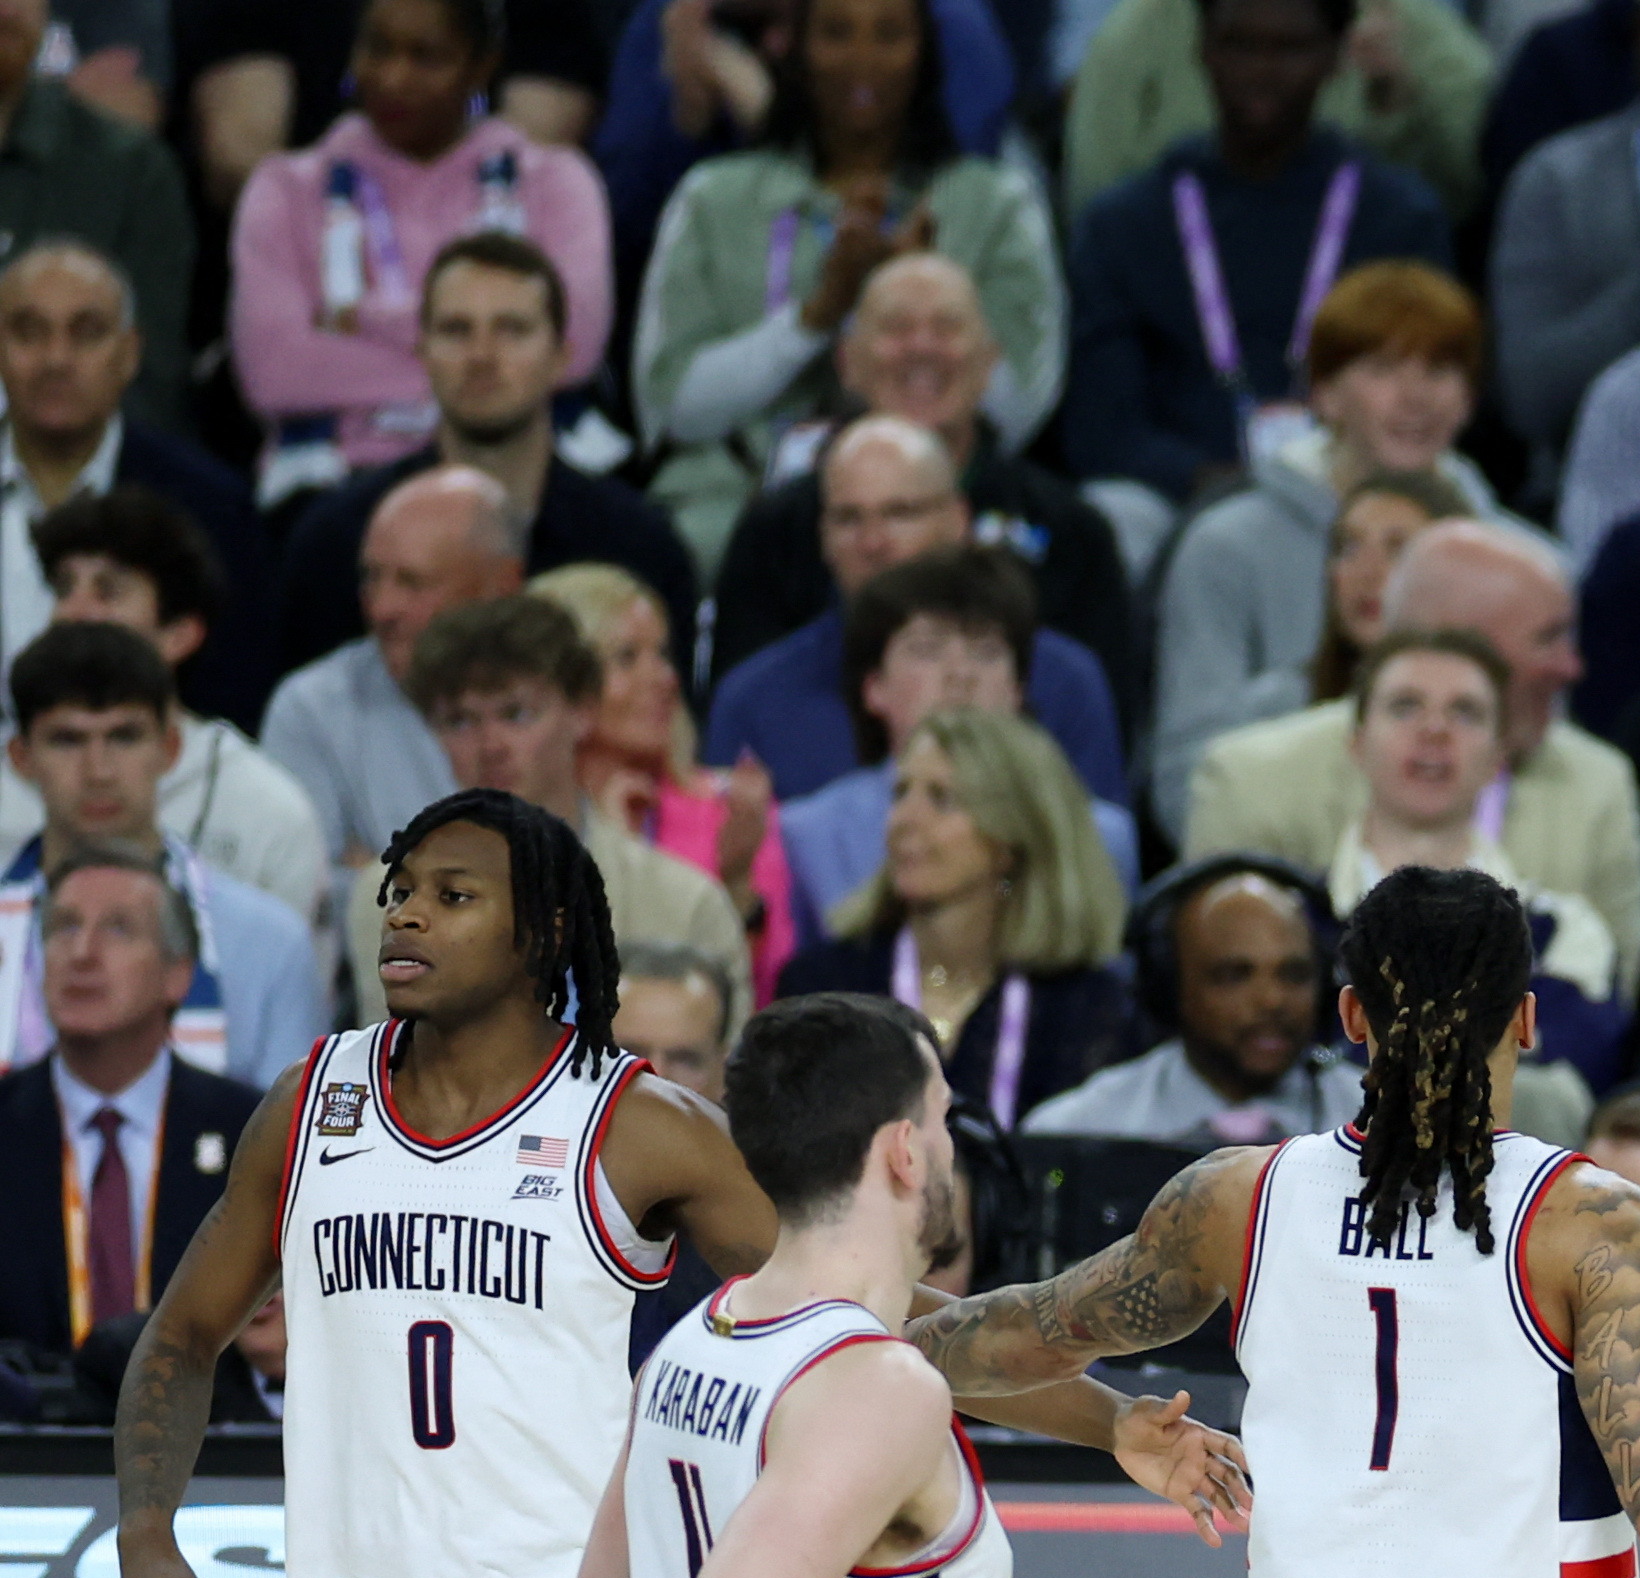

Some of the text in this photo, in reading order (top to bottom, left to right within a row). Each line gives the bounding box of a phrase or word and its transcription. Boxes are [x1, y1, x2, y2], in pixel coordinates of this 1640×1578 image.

[323, 1114, 355, 1128] FOUR
[327, 1091, 361, 1105] FINAL
[515, 1185, 564, 1197] EAST
[521, 1174, 557, 1187] BIG
[1338, 1196, 1434, 1261] BALL
[313, 1211, 551, 1312] CONNECTICUT
[407, 1319, 456, 1450] 0
[644, 1359, 762, 1447] KARABAN
[1367, 1286, 1399, 1471] 1
